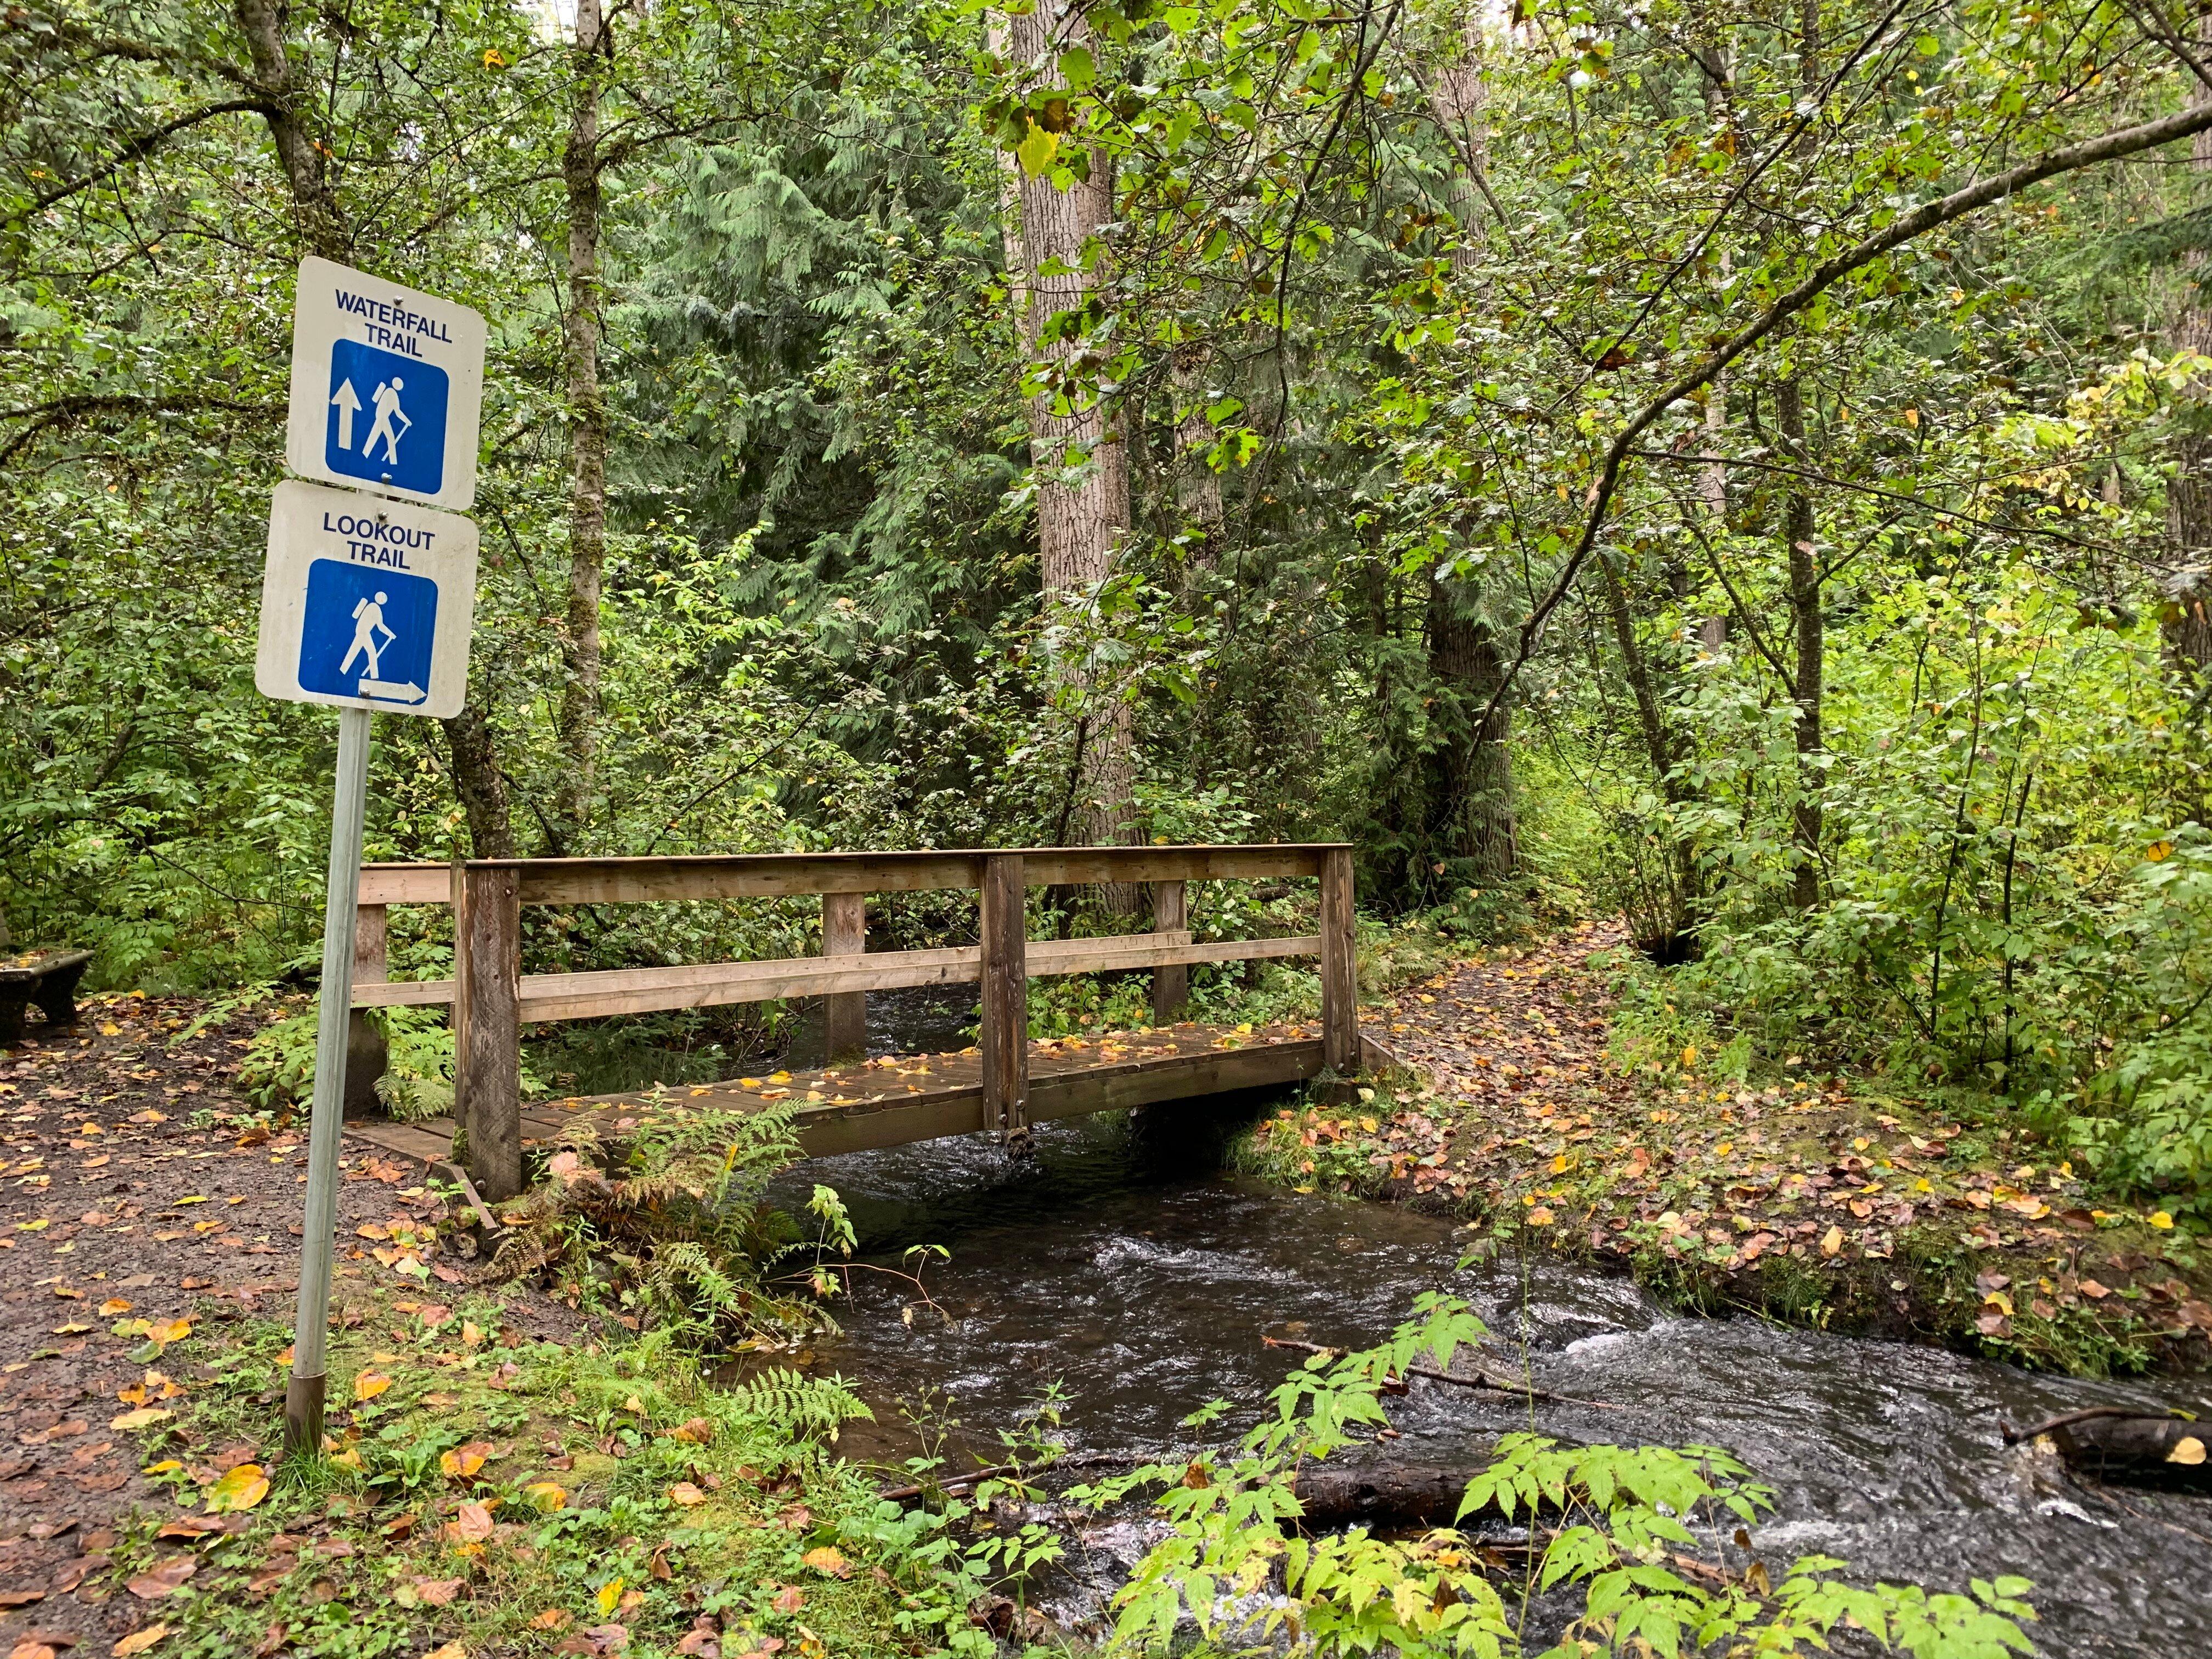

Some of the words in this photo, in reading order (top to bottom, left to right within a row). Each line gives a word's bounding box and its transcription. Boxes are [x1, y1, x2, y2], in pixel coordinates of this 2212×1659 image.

[335, 289, 452, 343] WATERFALL
[365, 323, 422, 358] TRAIL
[323, 512, 435, 550] LOOKOUT
[347, 540, 410, 569] TRAIL
